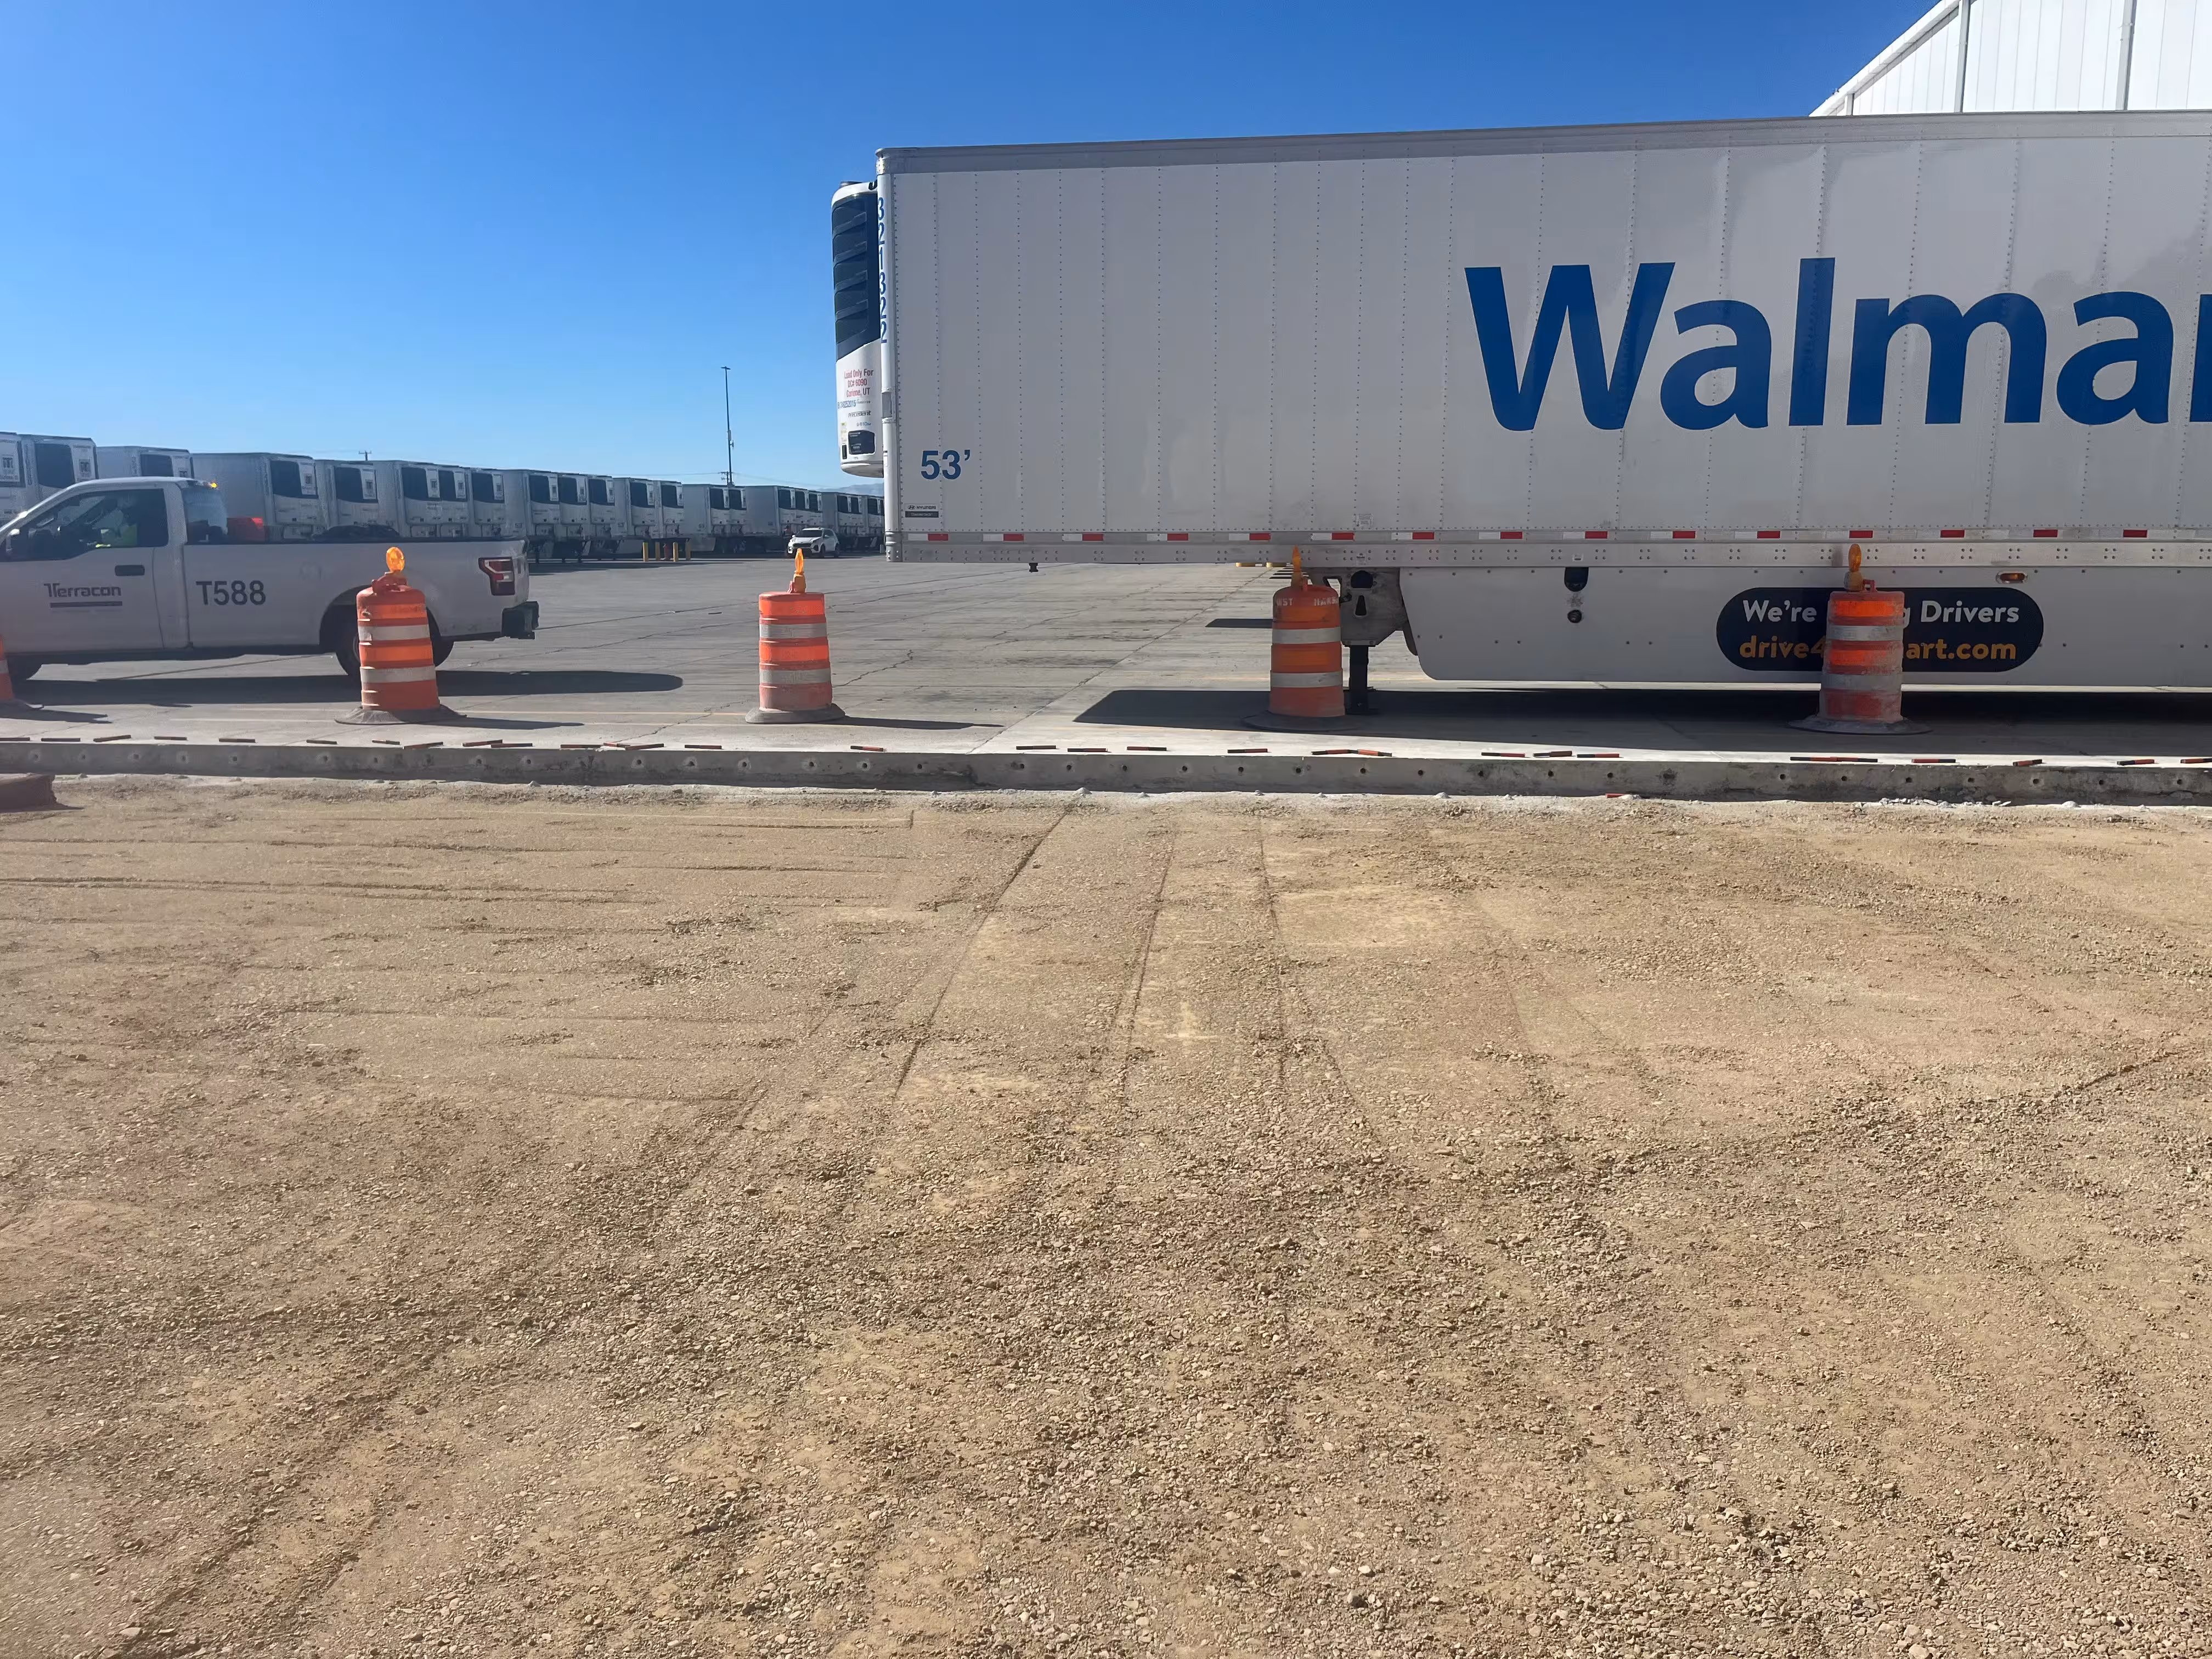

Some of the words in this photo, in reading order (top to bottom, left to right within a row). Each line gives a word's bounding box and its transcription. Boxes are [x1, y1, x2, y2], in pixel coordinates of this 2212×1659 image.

[864, 368, 874, 376] For
[43, 583, 122, 597] Terracon
[195, 580, 266, 606] T588
[1743, 600, 1817, 623] We're
[1920, 600, 2020, 623] Drivers
